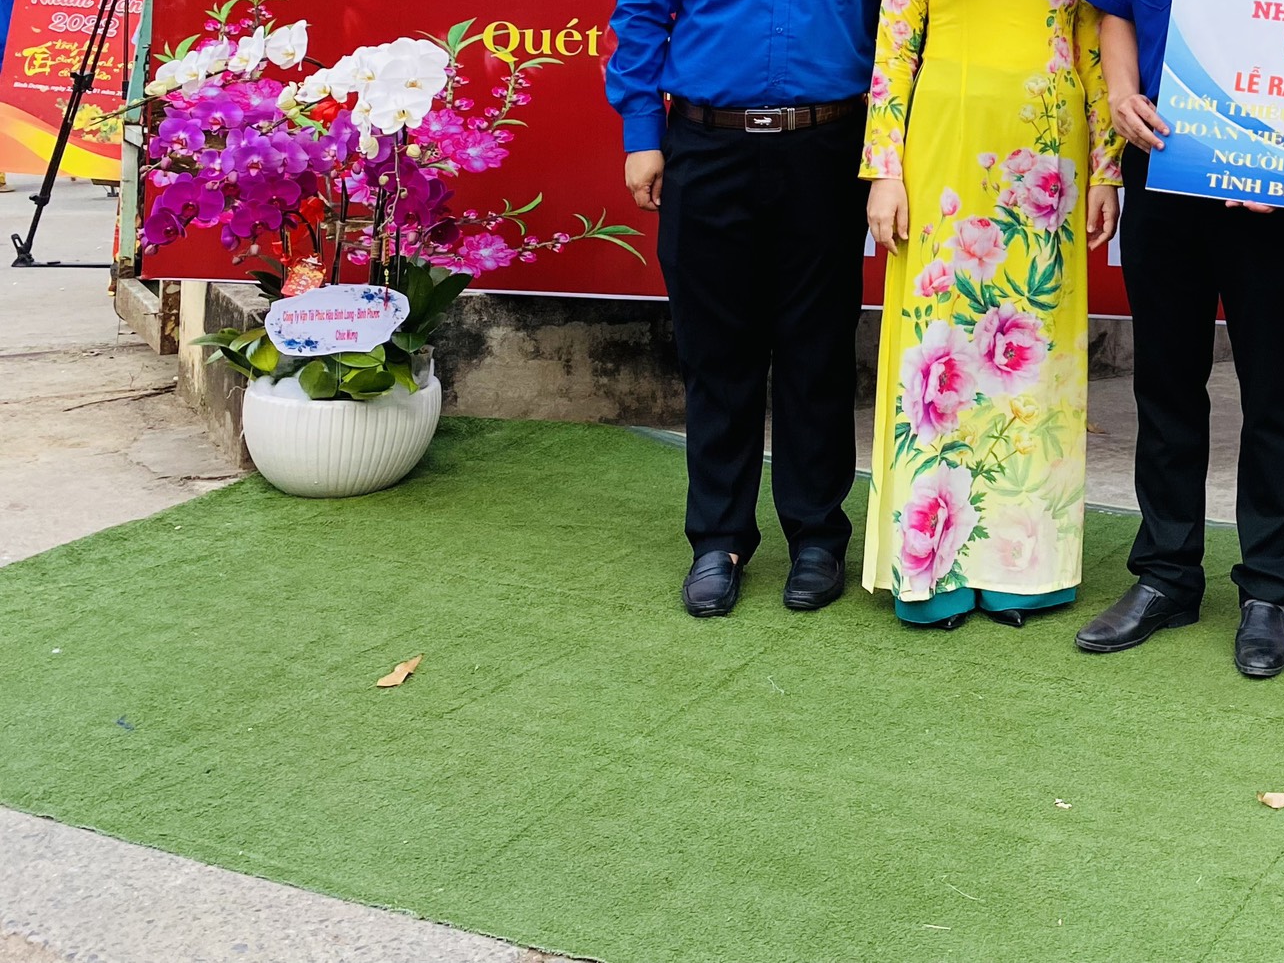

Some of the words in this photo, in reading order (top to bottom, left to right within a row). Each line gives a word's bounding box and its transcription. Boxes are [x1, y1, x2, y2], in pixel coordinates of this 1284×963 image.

[482, 17, 603, 63] Quét
[1234, 66, 1262, 94] LỄ
[1170, 93, 1218, 113] GIỚI
[1211, 149, 1284, 172] NGƯỜI
[1206, 170, 1262, 194] TỈNH
